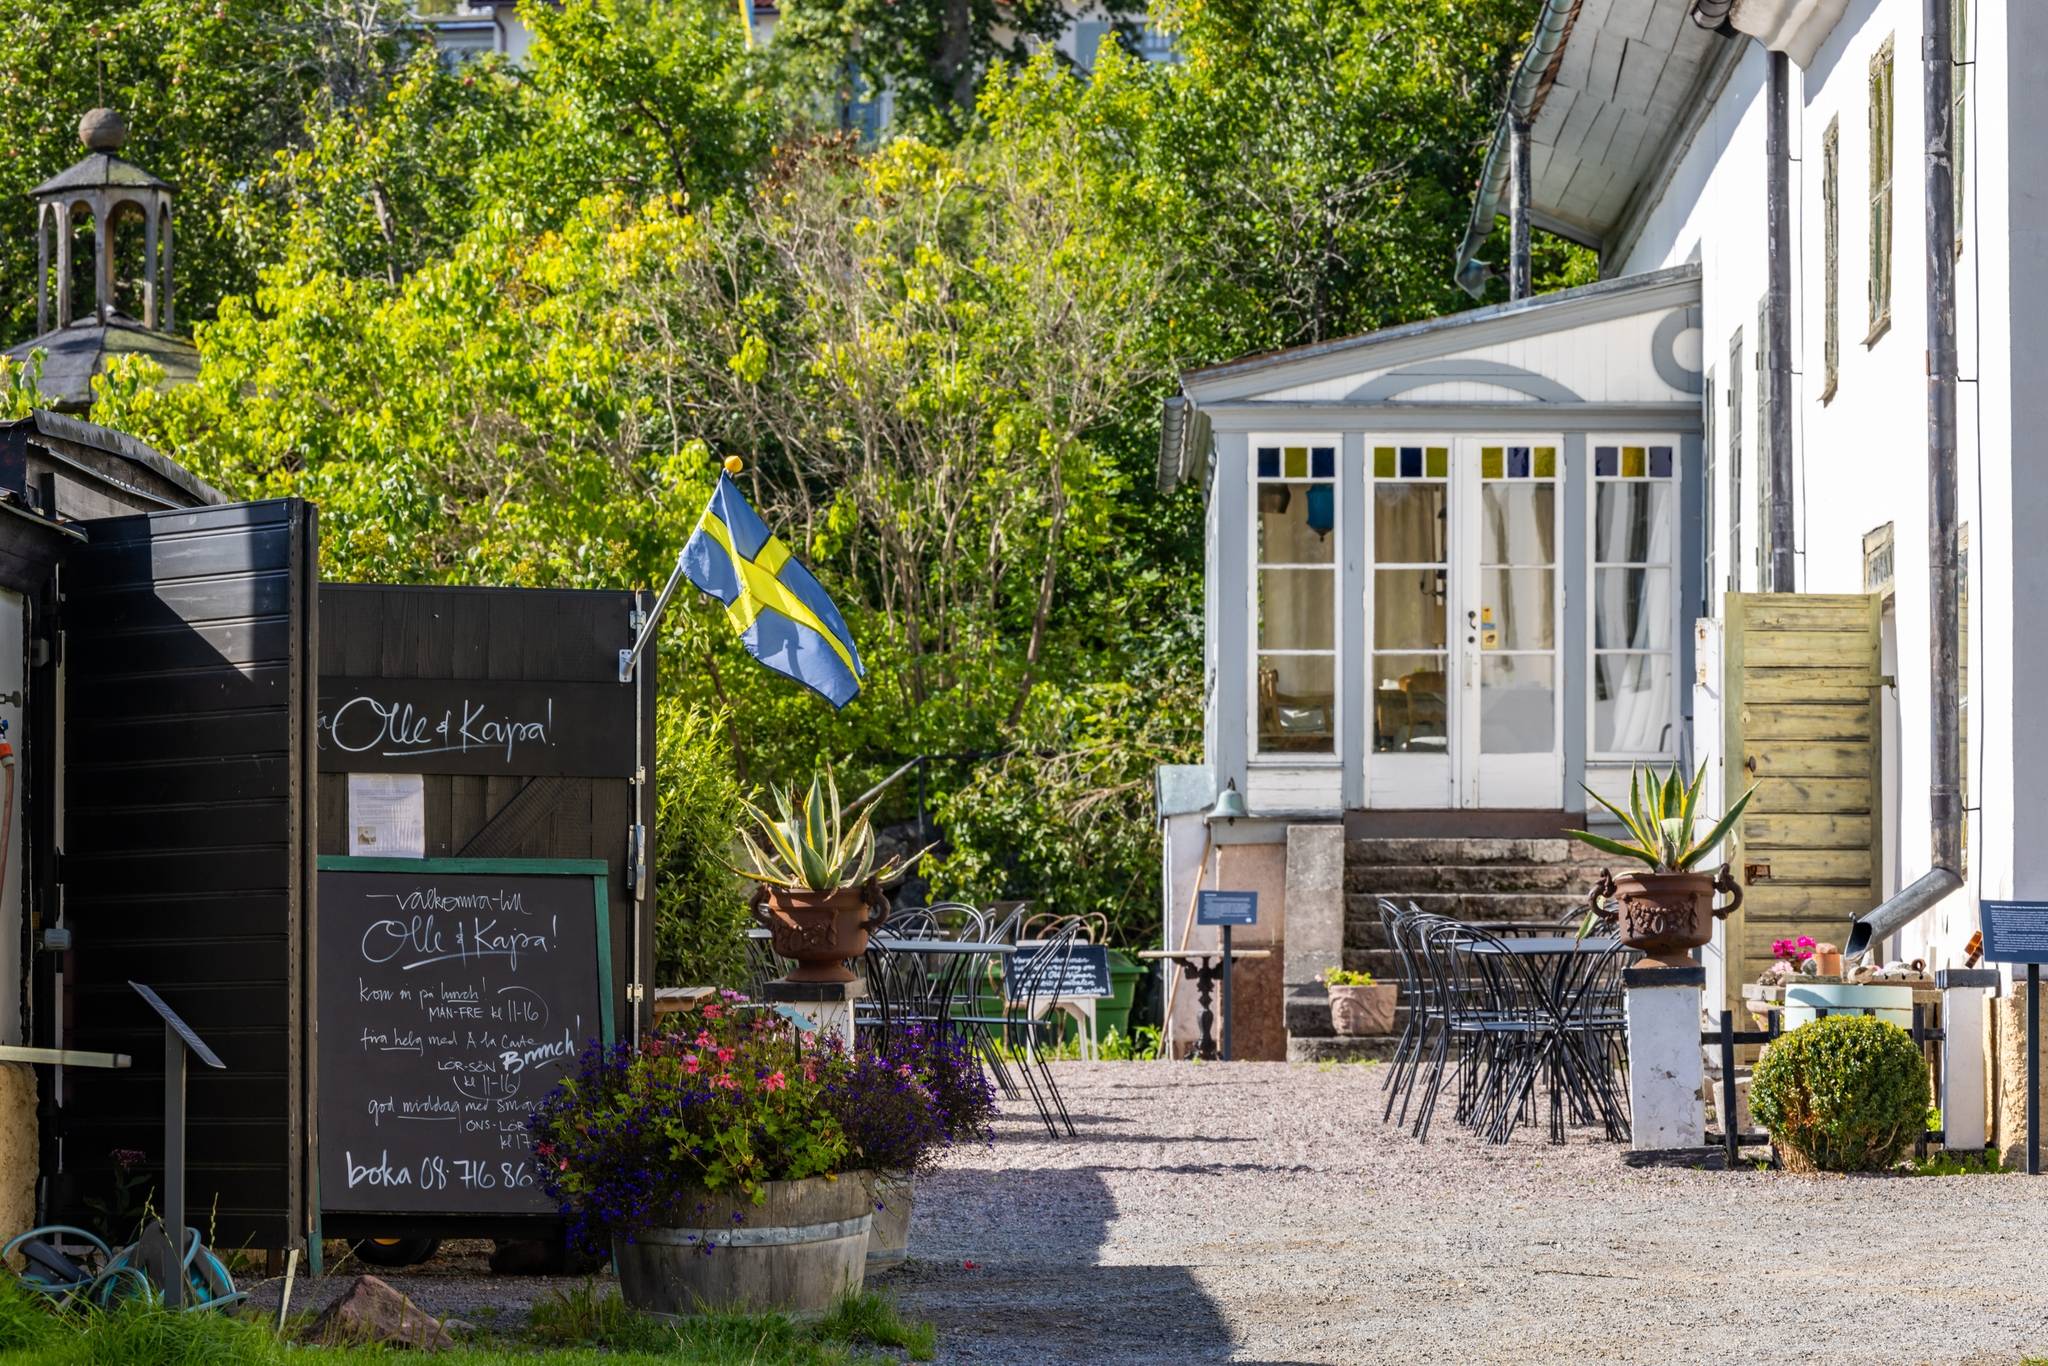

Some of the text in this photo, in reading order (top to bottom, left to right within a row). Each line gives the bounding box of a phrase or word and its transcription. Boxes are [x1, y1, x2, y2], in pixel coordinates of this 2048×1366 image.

[332, 696, 432, 752] Olle
[362, 914, 446, 963] Olle
[359, 976, 394, 1003] kom
[419, 985, 435, 1010] på
[393, 1027, 424, 1056] helg
[428, 1029, 458, 1046] med
[501, 1033, 538, 1050] Carte
[368, 1096, 395, 1127] god
[402, 1095, 462, 1133] middag
[465, 1098, 489, 1112] med
[345, 1150, 413, 1188] boka
